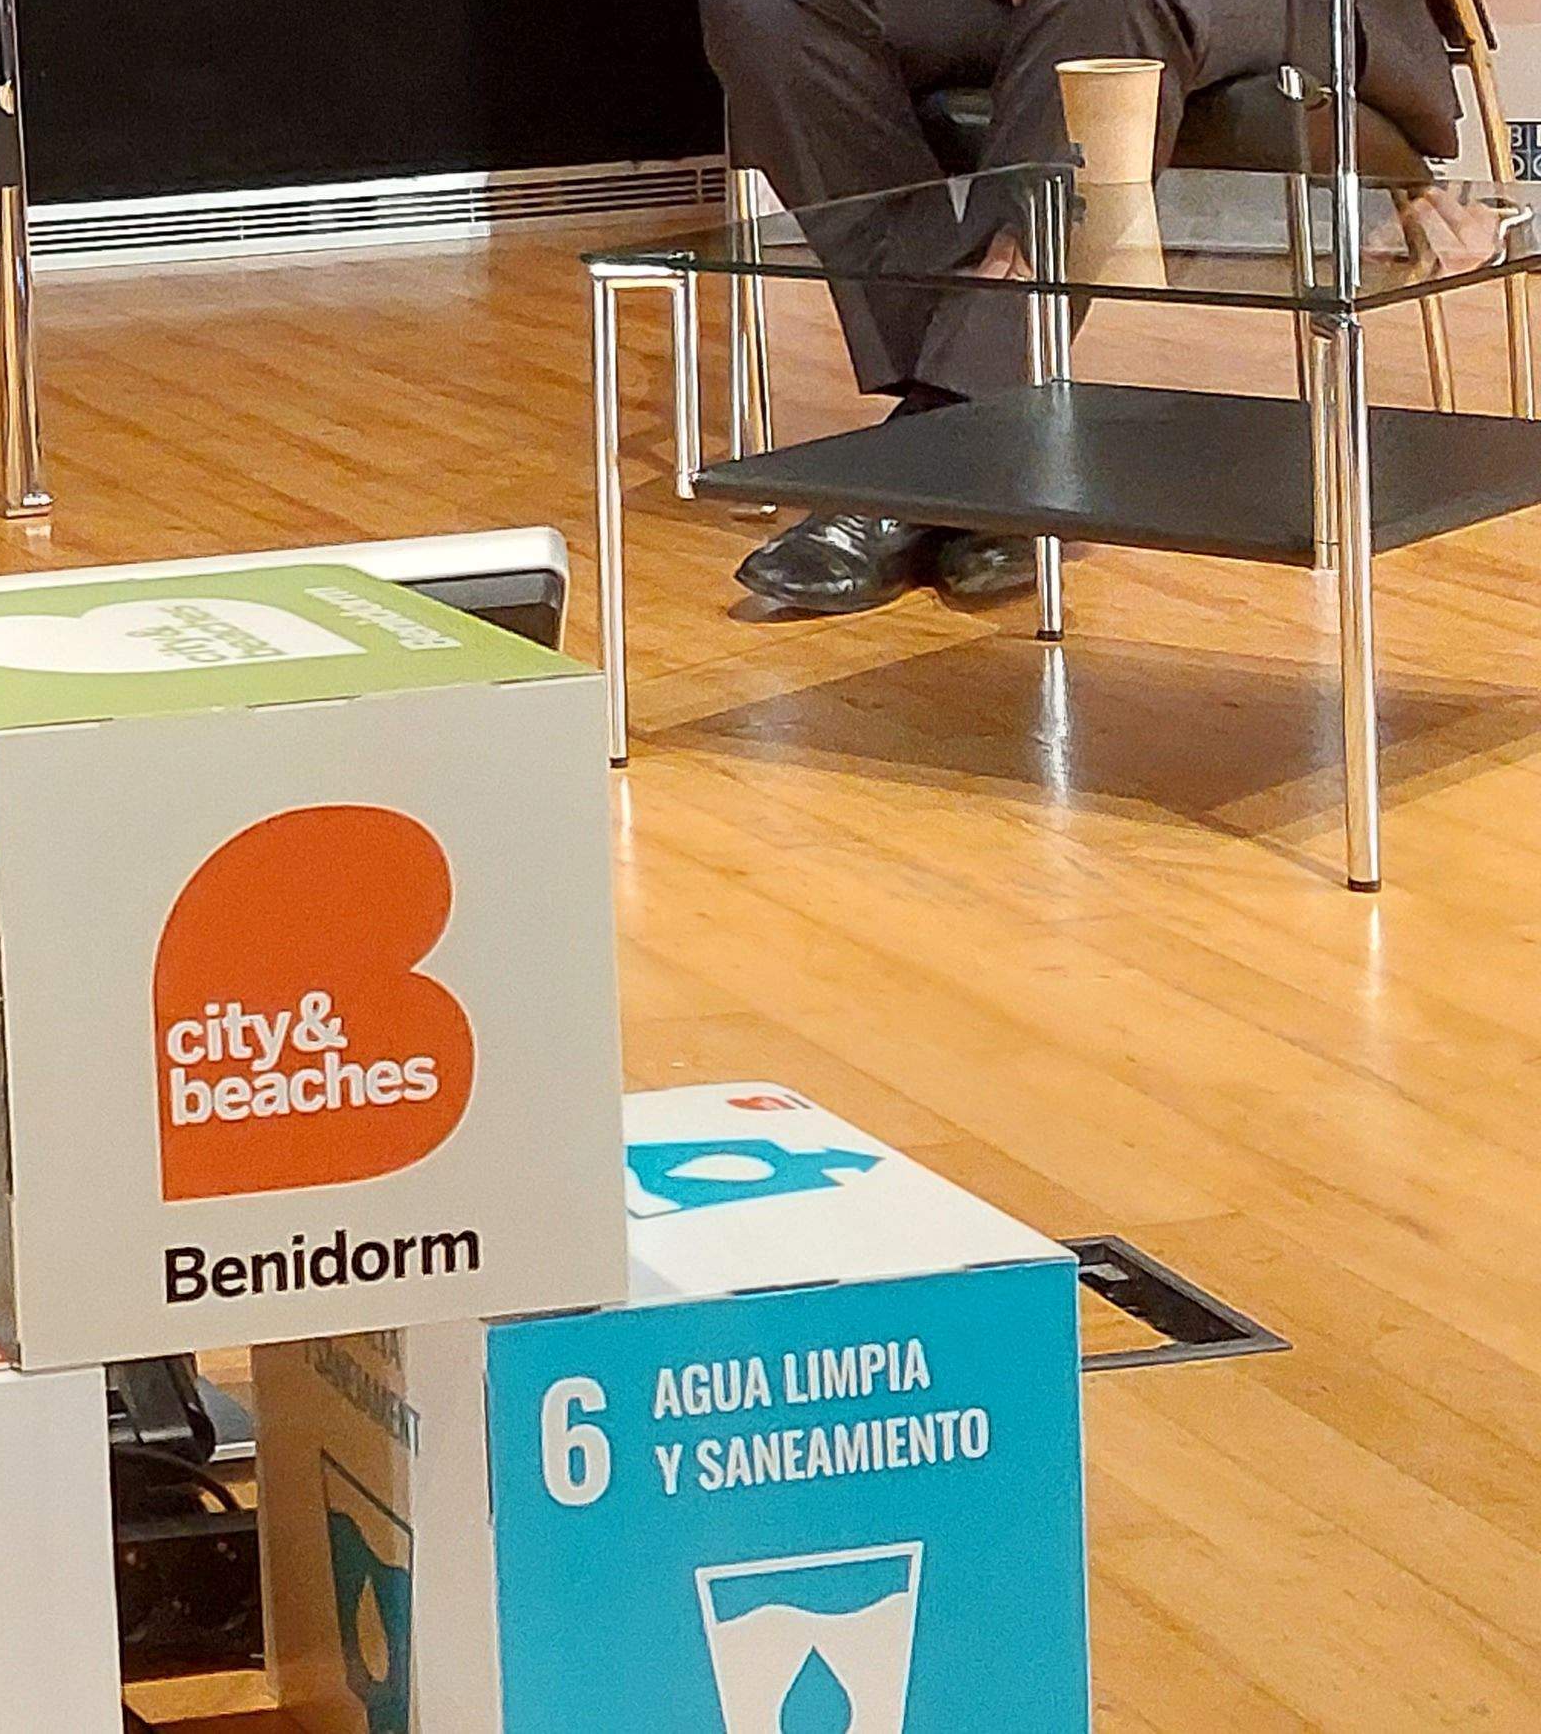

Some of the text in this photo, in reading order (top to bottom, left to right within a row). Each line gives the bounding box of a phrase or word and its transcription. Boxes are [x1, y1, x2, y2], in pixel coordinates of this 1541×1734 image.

[165, 990, 348, 1069] city&
[169, 1052, 439, 1128] beaches
[162, 1226, 482, 1306] Benidorm
[652, 1338, 933, 1420] AGUA LIMPIA
[539, 1375, 612, 1507] 6
[653, 1407, 992, 1497] Y SANEAMIENTO
